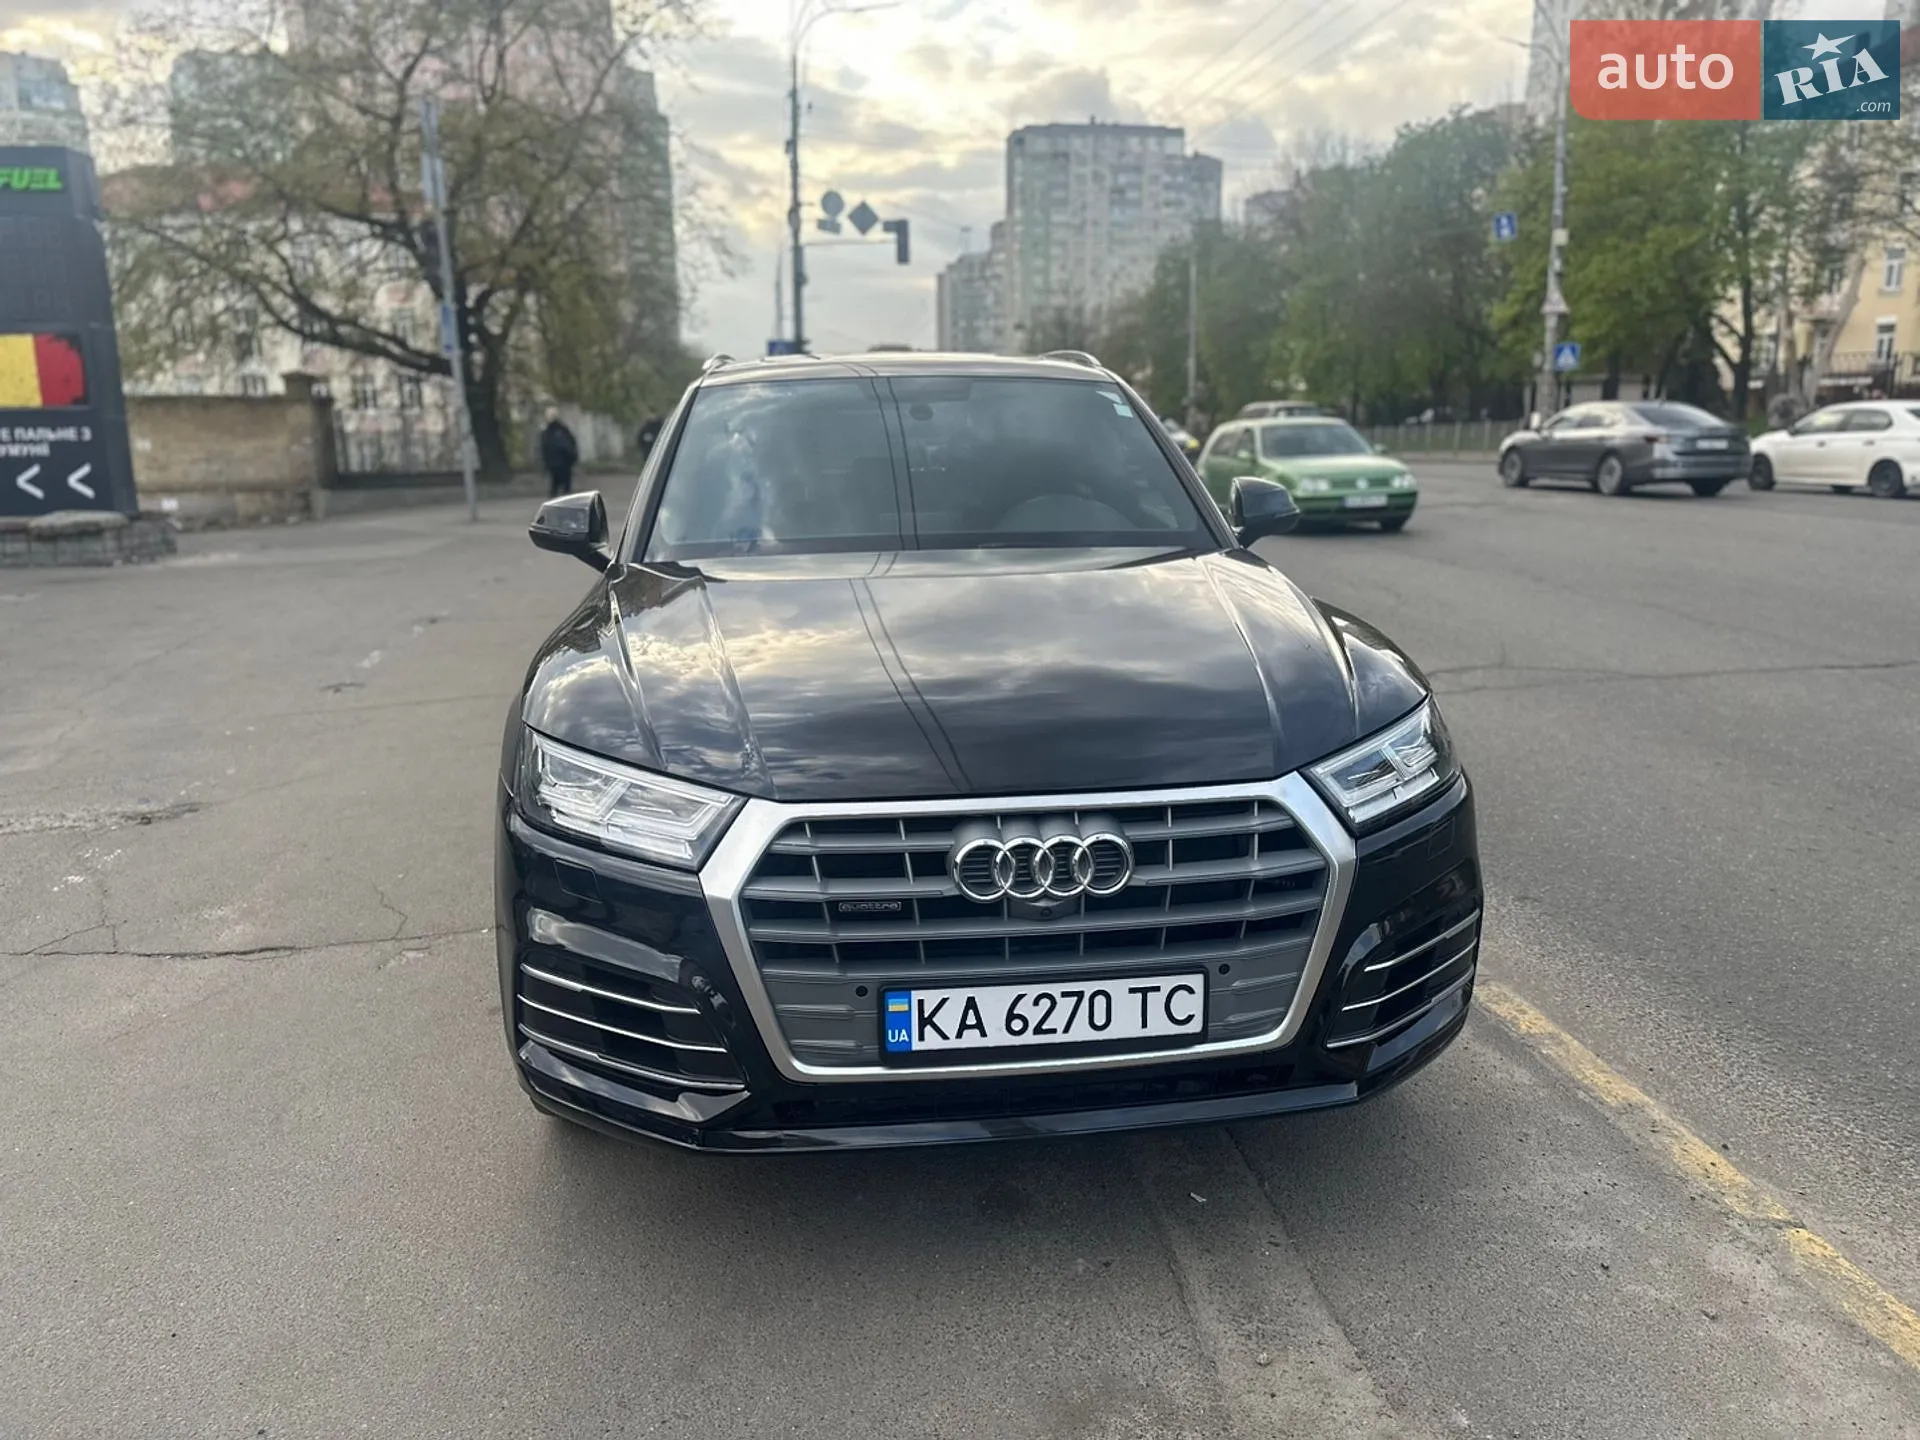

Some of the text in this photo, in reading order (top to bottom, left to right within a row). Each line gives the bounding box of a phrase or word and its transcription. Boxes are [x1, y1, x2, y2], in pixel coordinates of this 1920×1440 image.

[841, 902, 899, 912] quattro
[917, 983, 1196, 1042] KA 6270 TC
[888, 1029, 909, 1043] UA
